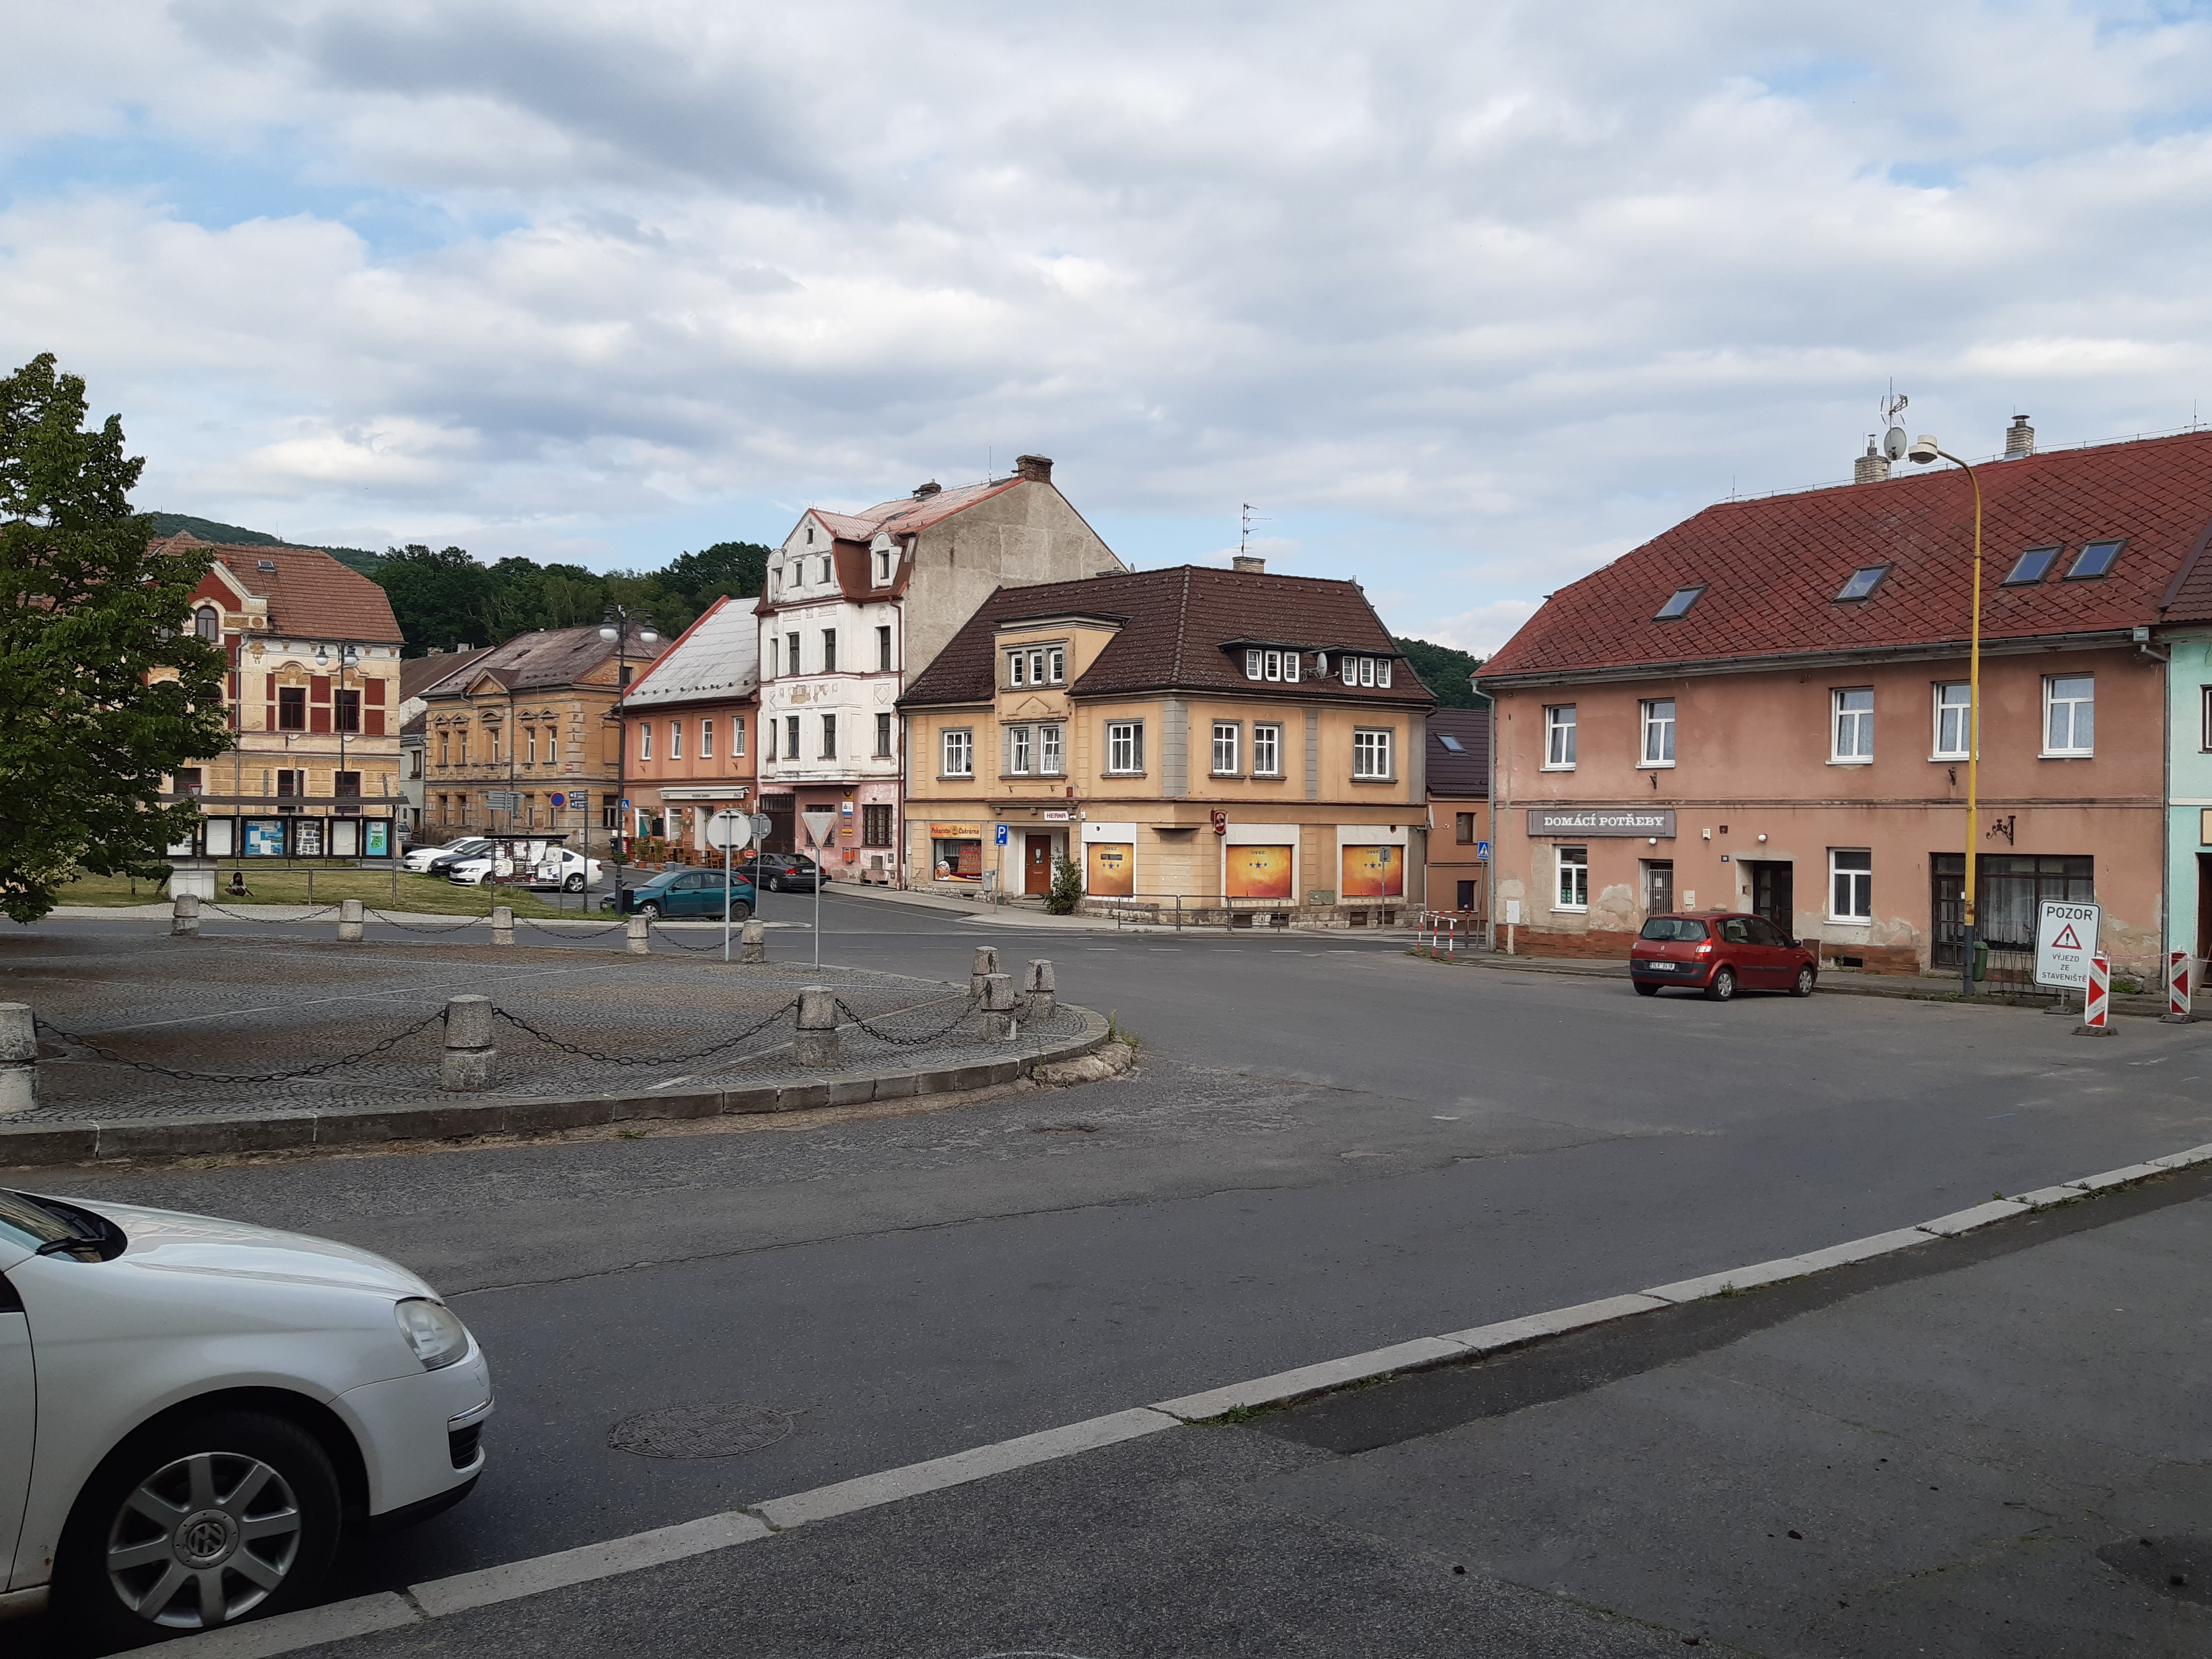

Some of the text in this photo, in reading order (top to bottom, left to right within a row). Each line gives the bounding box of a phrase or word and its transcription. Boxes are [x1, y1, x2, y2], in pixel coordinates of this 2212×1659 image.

[1544, 813, 1664, 827] DOMÁCÍ POTŘEBY
[998, 826, 1006, 839] P
[2047, 906, 2092, 921] POZOR
[2052, 953, 2080, 962] VÝJEZD
[2042, 972, 2086, 983] STAVENIŠTĚ
